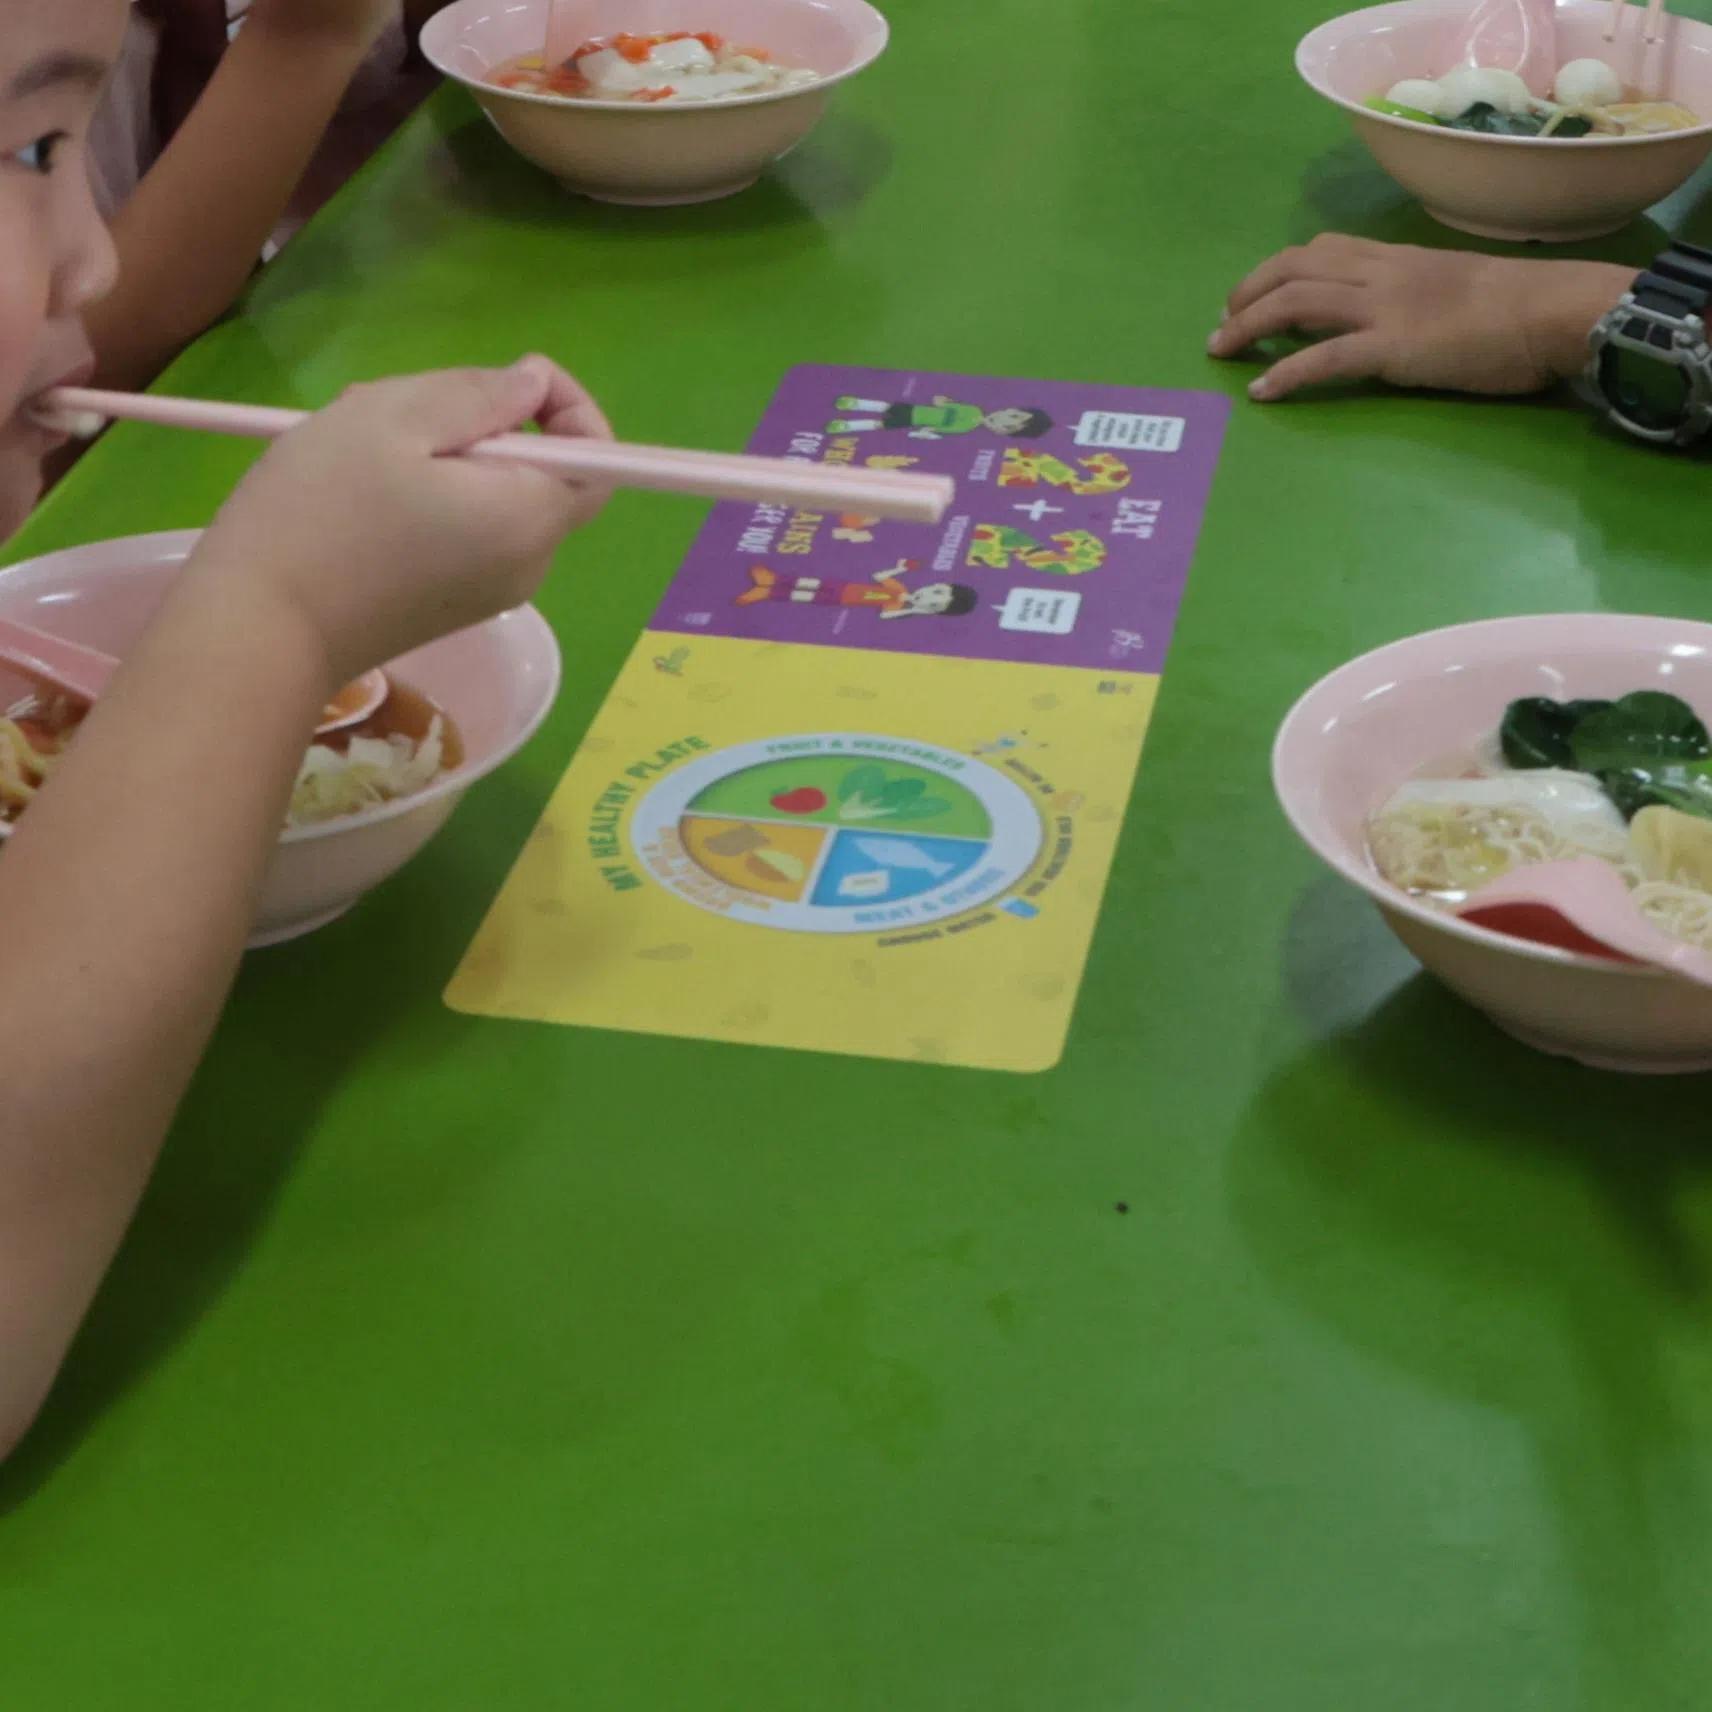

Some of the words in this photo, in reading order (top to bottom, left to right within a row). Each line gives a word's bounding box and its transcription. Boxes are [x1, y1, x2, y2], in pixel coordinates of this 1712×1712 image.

[786, 432, 824, 454] FOR
[968, 449, 996, 481] FRUITS
[1110, 497, 1163, 539] EAT
[735, 526, 779, 554] YOU!
[933, 515, 970, 571] VEGETABLES
[625, 735, 711, 780] PLATE
[589, 780, 636, 858] HEALTHY
[600, 865, 643, 892] MY
